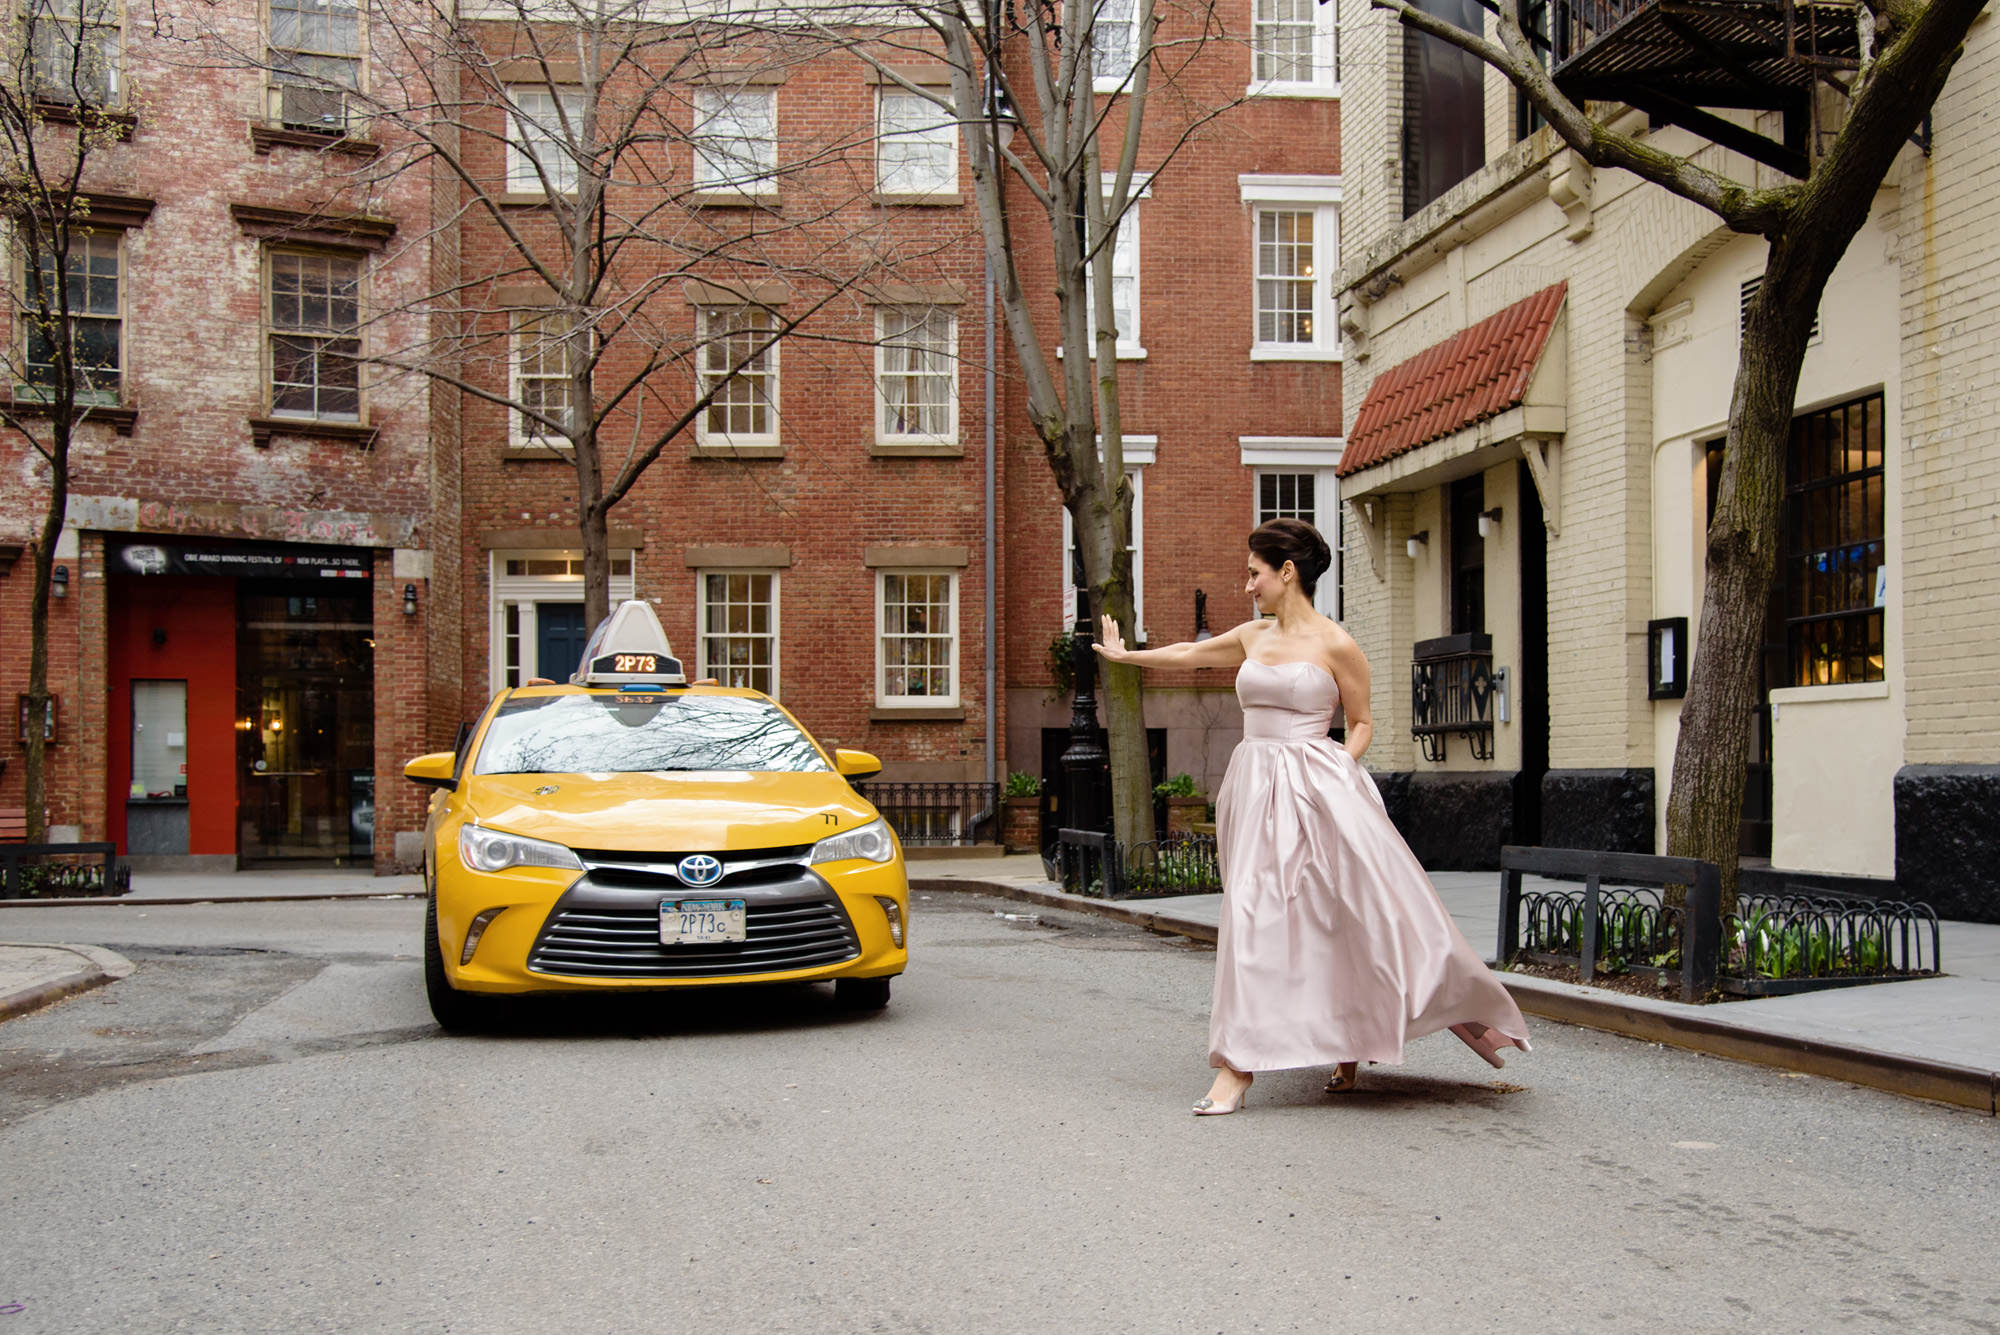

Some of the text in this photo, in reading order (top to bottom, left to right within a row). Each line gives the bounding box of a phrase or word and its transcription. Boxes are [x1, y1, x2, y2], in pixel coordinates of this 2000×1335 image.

[199, 554, 220, 562] AWARD
[221, 555, 247, 563] WINNING
[247, 555, 273, 564] FESTIVAL
[615, 655, 656, 672] 2P73
